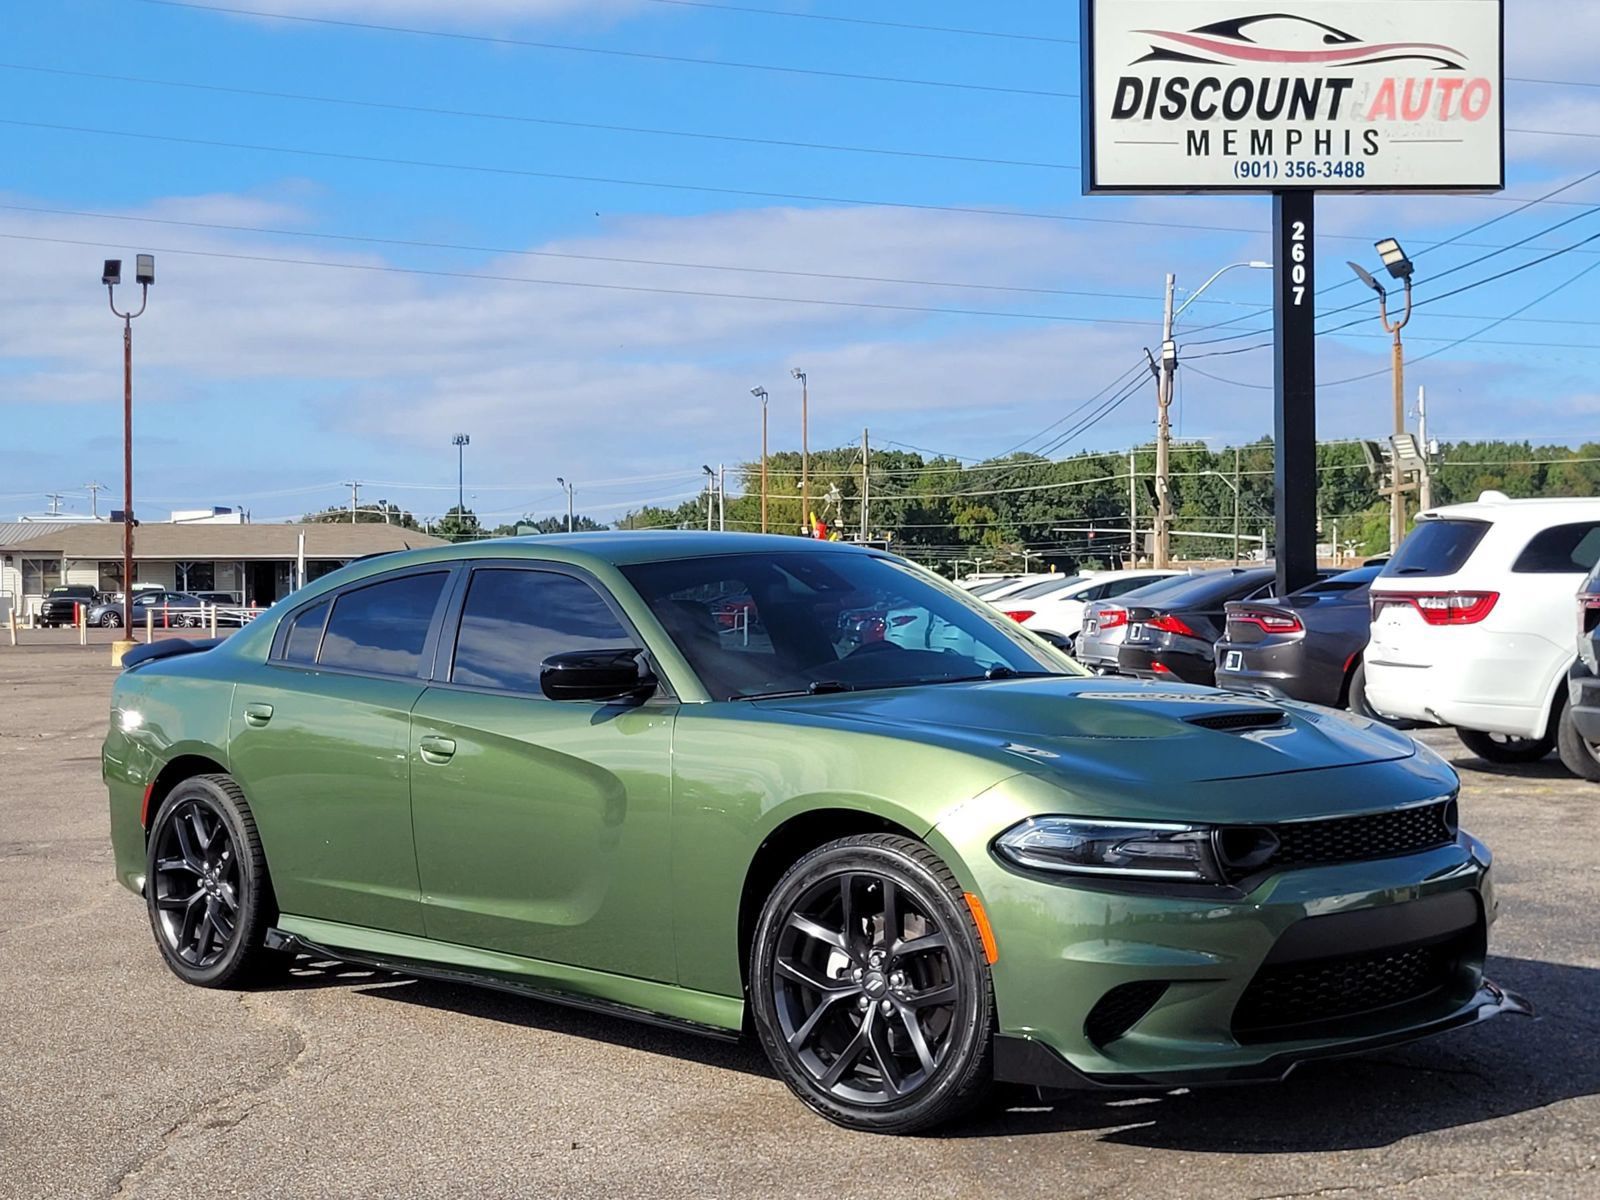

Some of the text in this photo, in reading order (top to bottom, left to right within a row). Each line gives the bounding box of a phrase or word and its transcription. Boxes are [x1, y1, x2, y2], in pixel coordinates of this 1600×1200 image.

[1110, 76, 1492, 122] DISCOUNT AUTO
[1186, 129, 1380, 157] MEMPHIS
[1234, 160, 1365, 179] (901) 356-3488
[1291, 221, 1305, 306] 2607
